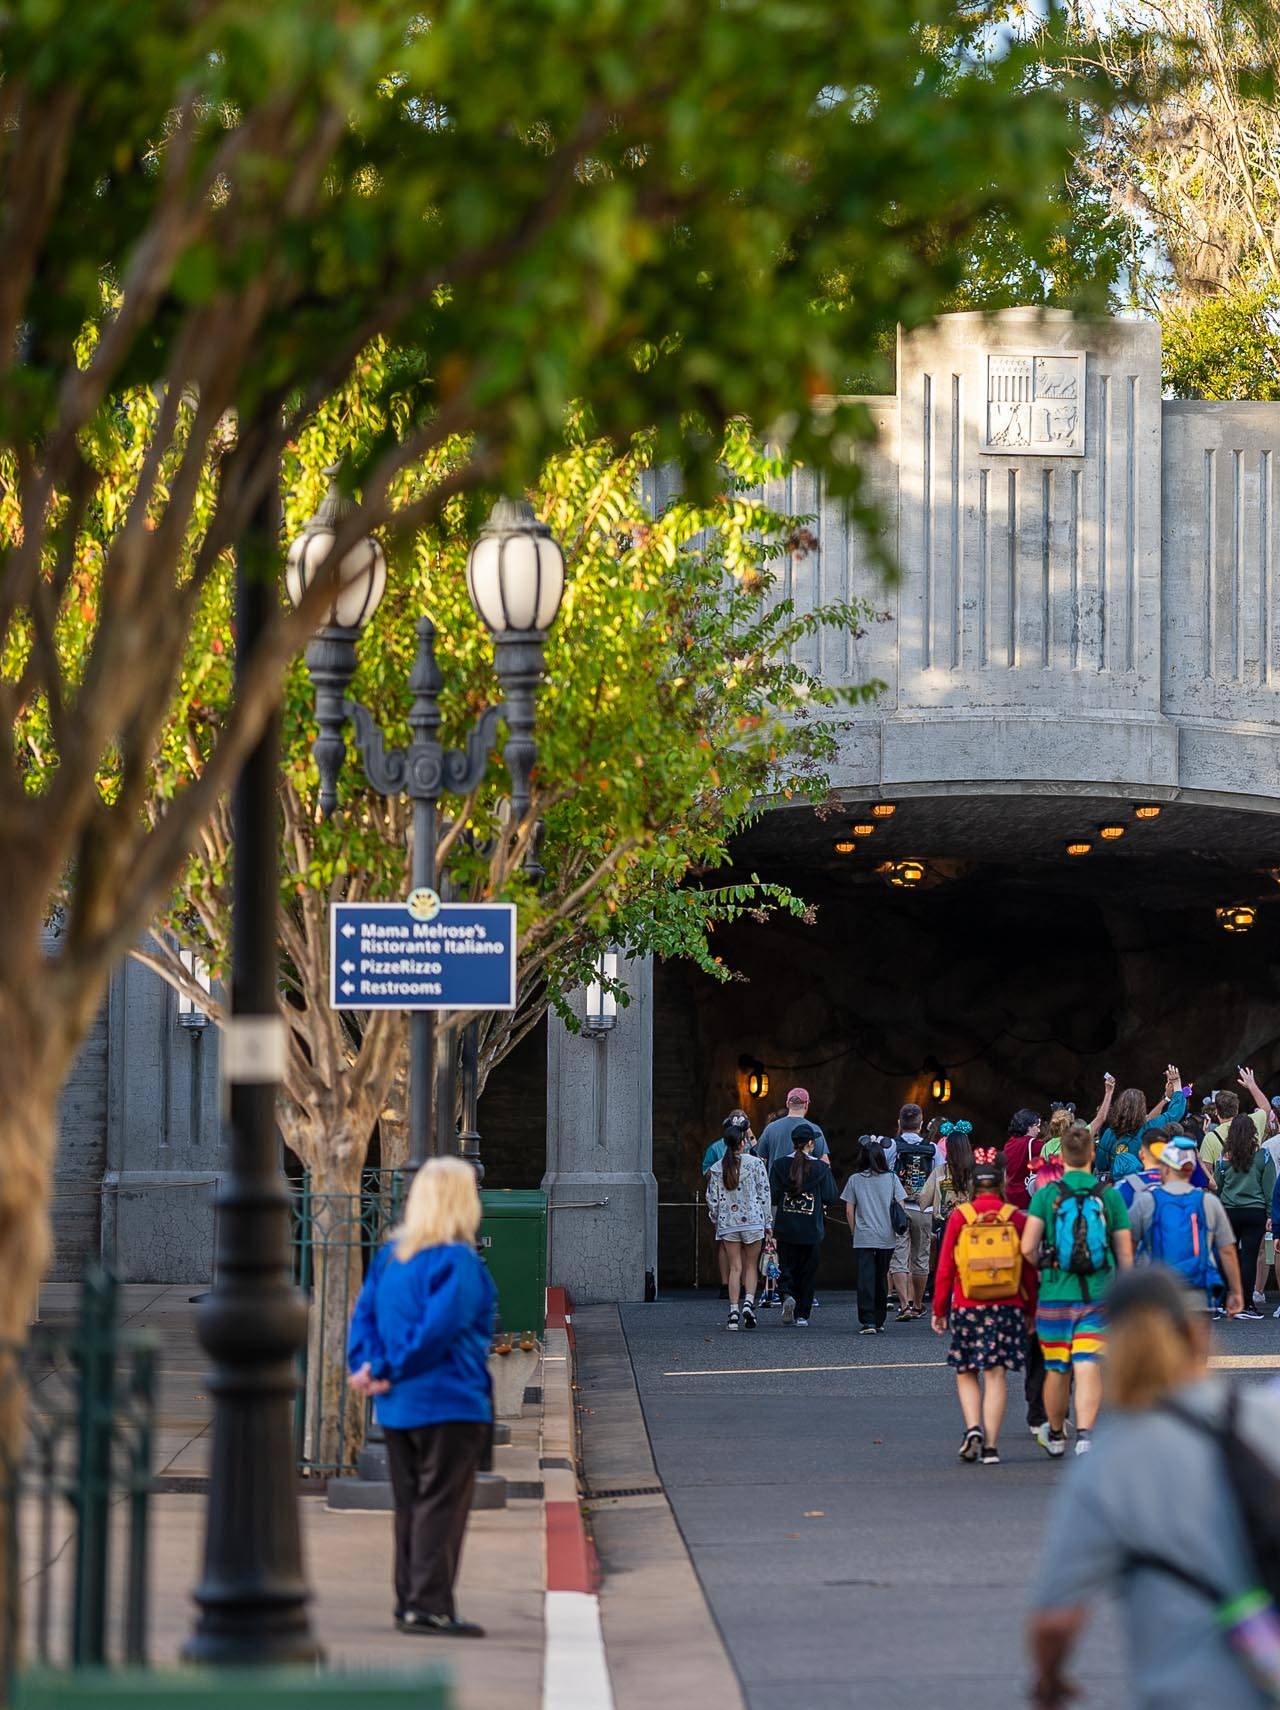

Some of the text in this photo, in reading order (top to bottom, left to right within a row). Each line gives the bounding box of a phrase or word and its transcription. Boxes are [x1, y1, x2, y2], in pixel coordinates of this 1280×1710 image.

[361, 923, 487, 939] Mama Melrose's
[361, 939, 504, 954] Ristorante Italiano
[361, 959, 442, 974] PizzeRizzo
[361, 980, 442, 995] Restrooms
